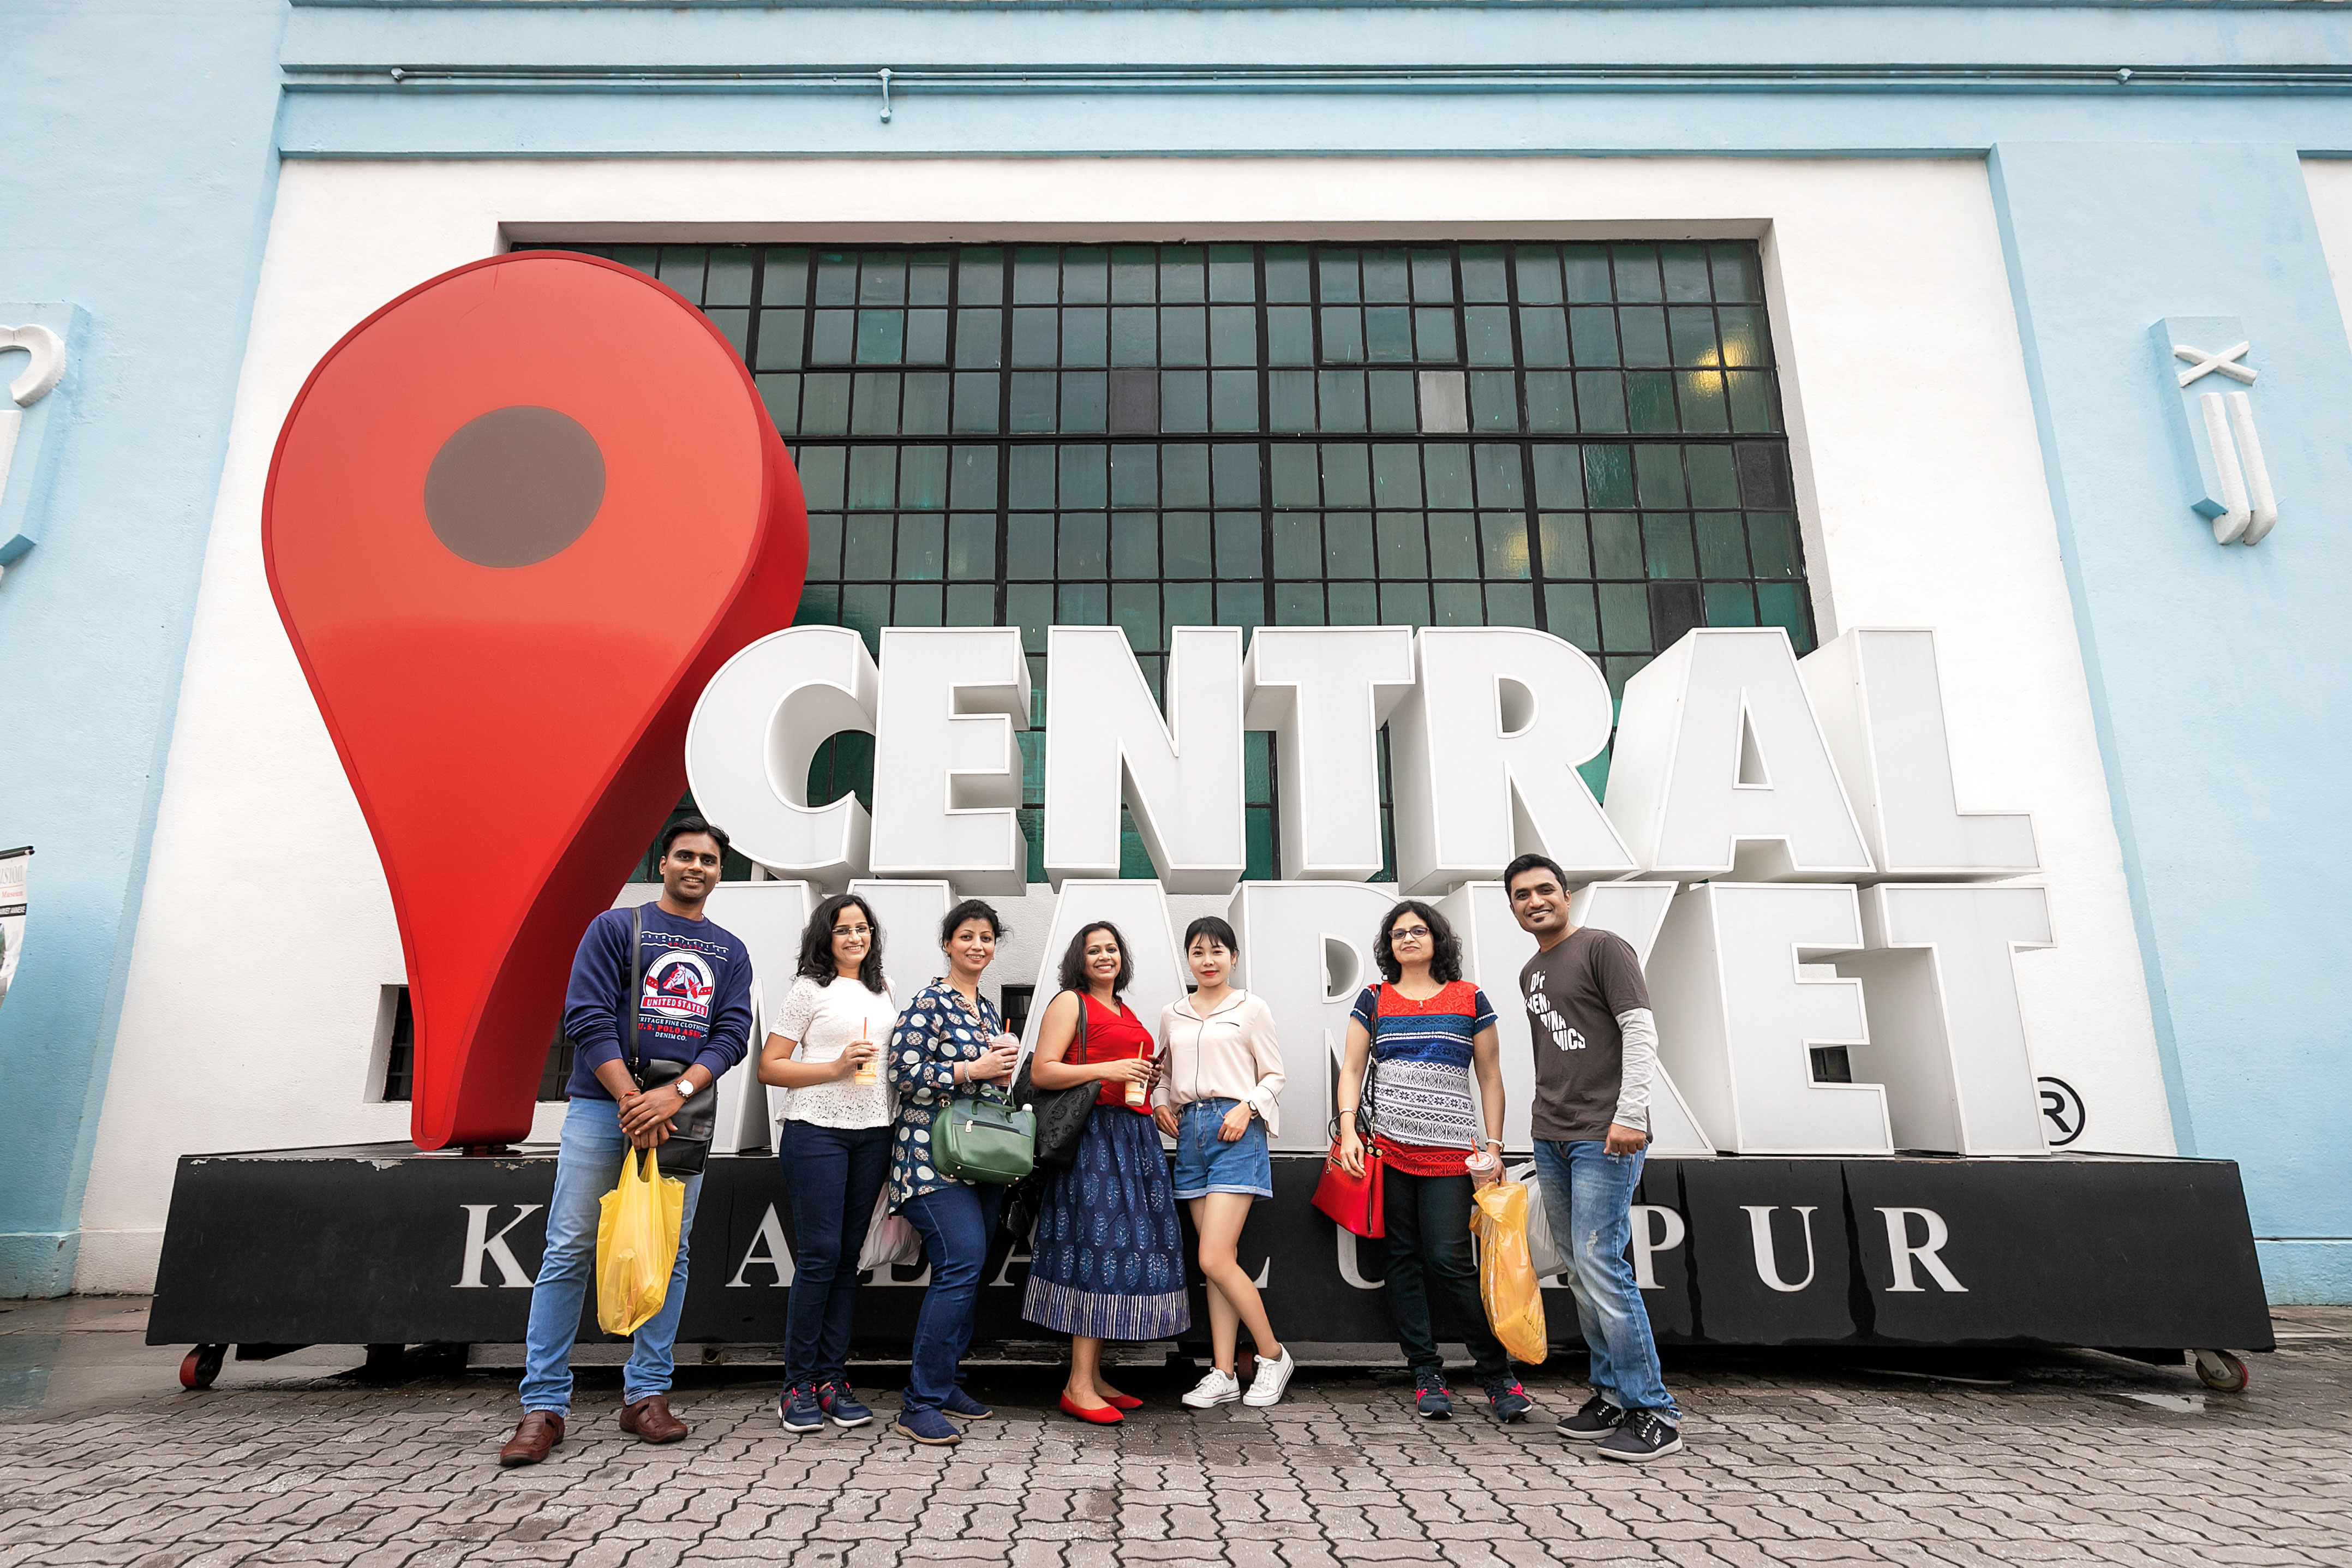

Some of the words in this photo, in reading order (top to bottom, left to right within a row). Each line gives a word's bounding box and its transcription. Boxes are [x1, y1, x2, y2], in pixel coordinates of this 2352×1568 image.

[685, 625, 2040, 879] CENTRAL
[647, 998, 676, 1007] UNITED
[677, 1000, 705, 1015] STATES
[656, 1025, 680, 1034] POLO
[680, 1022, 708, 1033] CLOTHING
